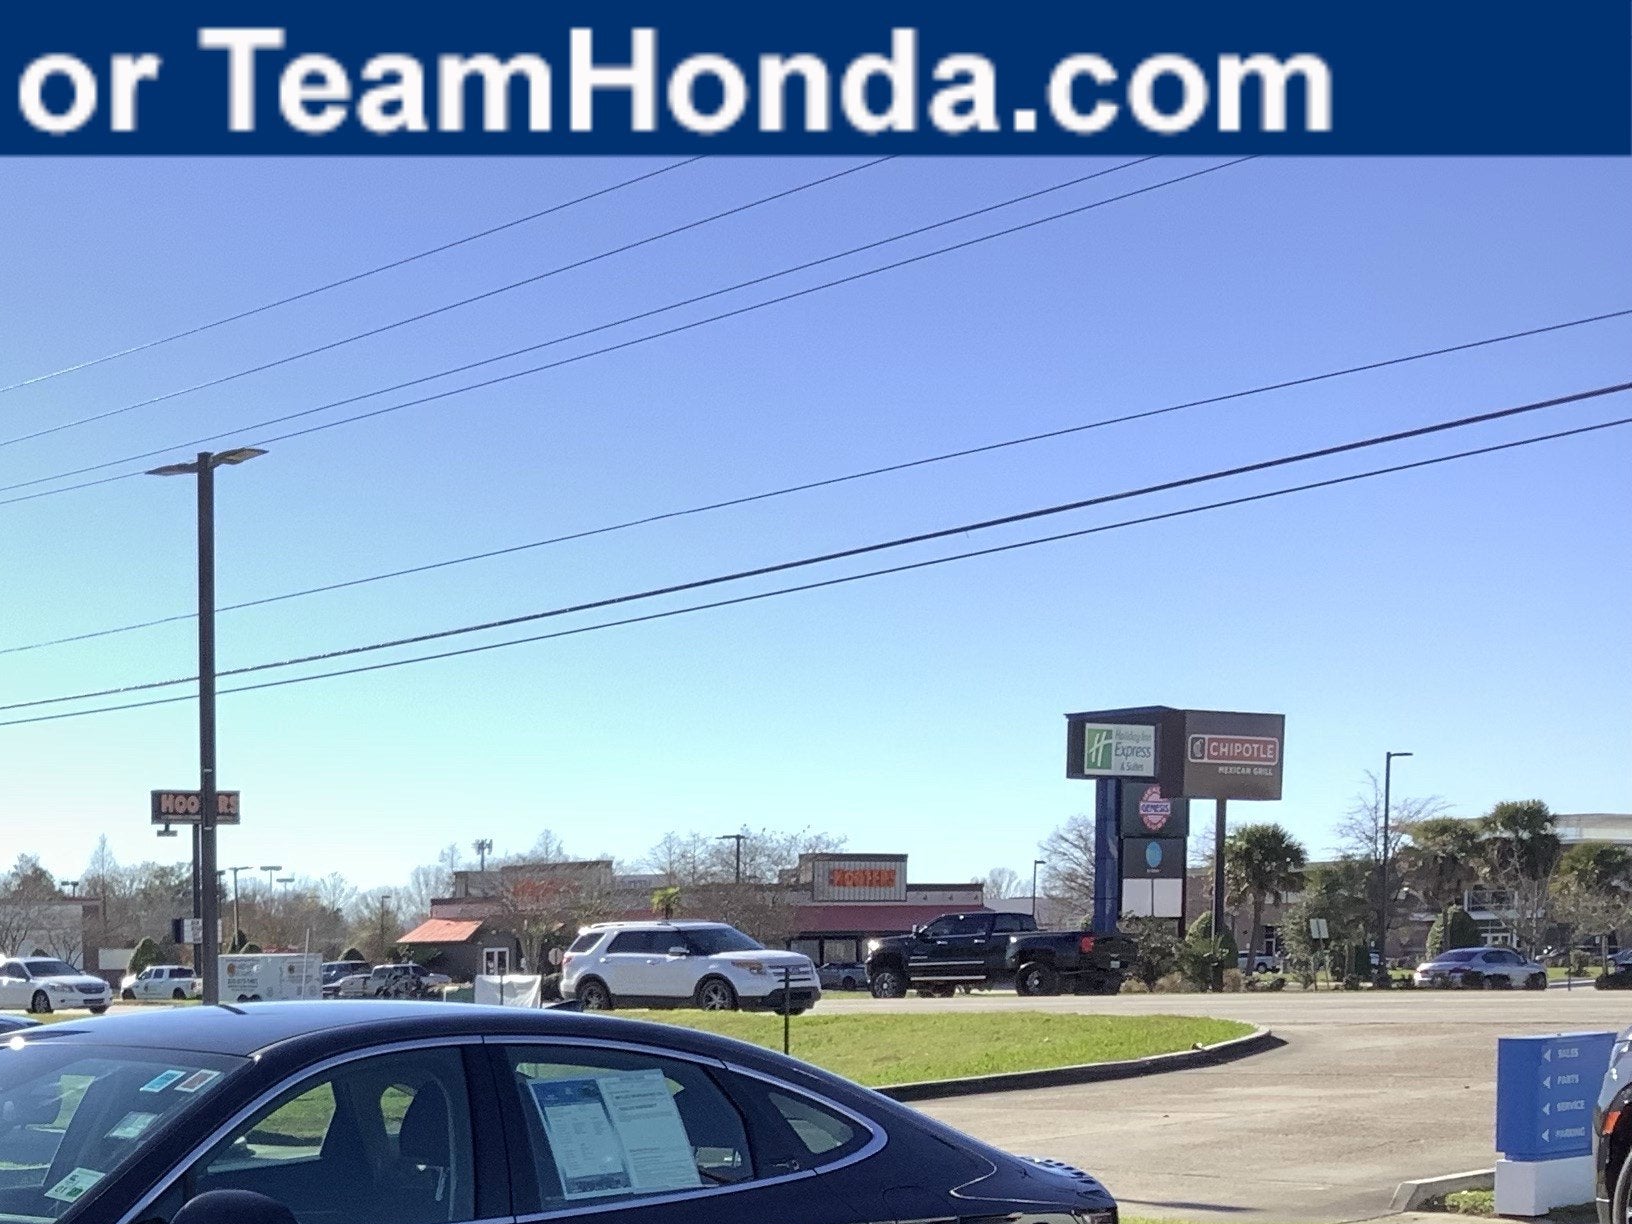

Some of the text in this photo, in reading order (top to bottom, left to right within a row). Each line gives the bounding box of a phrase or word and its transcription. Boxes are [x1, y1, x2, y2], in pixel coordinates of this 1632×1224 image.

[1115, 741, 1152, 759] Express
[1210, 742, 1274, 758] CHIPOTLE
[1218, 766, 1273, 776] MEXICAN GRILL
[161, 794, 237, 814] HOORS
